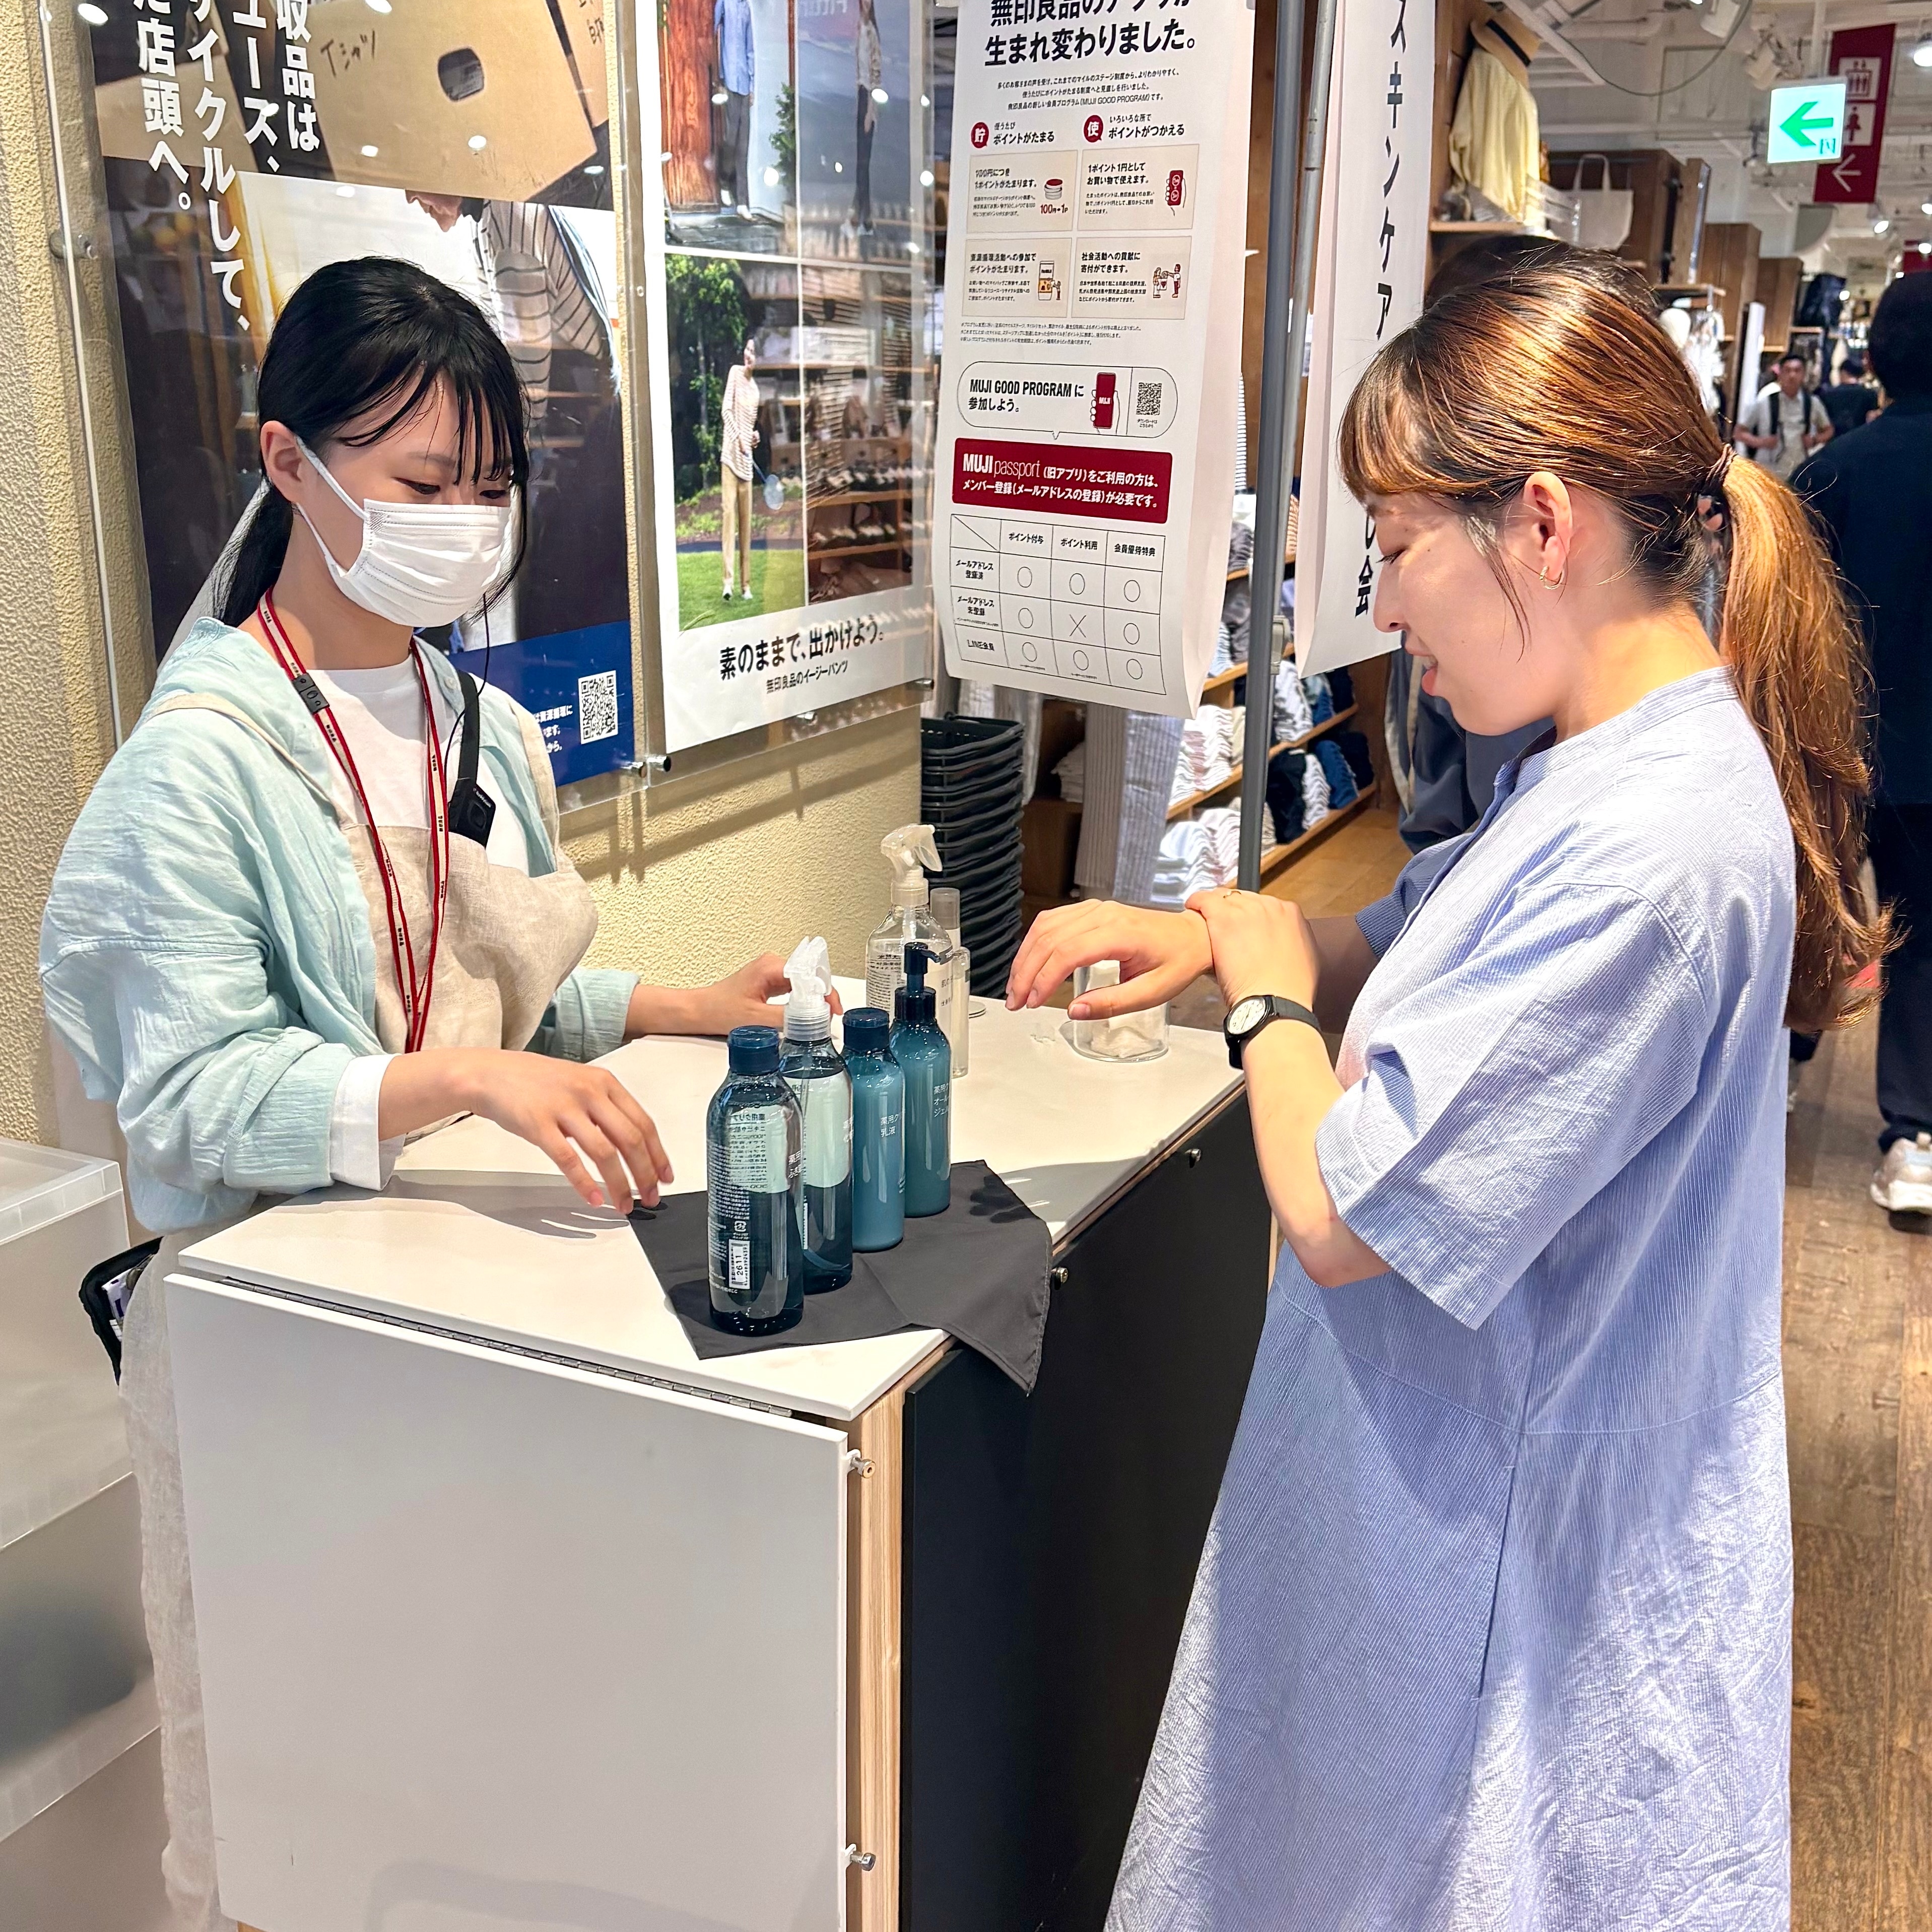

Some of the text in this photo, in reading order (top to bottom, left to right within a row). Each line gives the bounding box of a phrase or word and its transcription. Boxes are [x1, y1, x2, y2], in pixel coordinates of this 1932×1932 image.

[985, 18, 1194, 66] 生まれ変わりました。
[1110, 114, 1152, 123] いろいろな所で
[1088, 121, 1099, 137] 使
[1108, 124, 1184, 139] ポイントがつかえる
[993, 131, 1054, 145] ポイントがたまる
[1087, 175, 1149, 185] お買い物で使えます。
[1082, 252, 1141, 261] 社会活動への貢献に
[1081, 264, 1128, 274] 寄付ができます。
[970, 379, 1084, 397] MUJI GOOD PROGRAM に
[968, 396, 1019, 412] 参加しよう。
[963, 453, 993, 474] MUJI
[993, 460, 1040, 480] passport
[1060, 538, 1098, 550] ポイント利用
[720, 615, 883, 681] 素のままで、出かけよう。
[766, 660, 848, 694] 無印良品のイージーパンツ
[881, 1126, 895, 1138] 乳液
[736, 1255, 744, 1276] 2611
